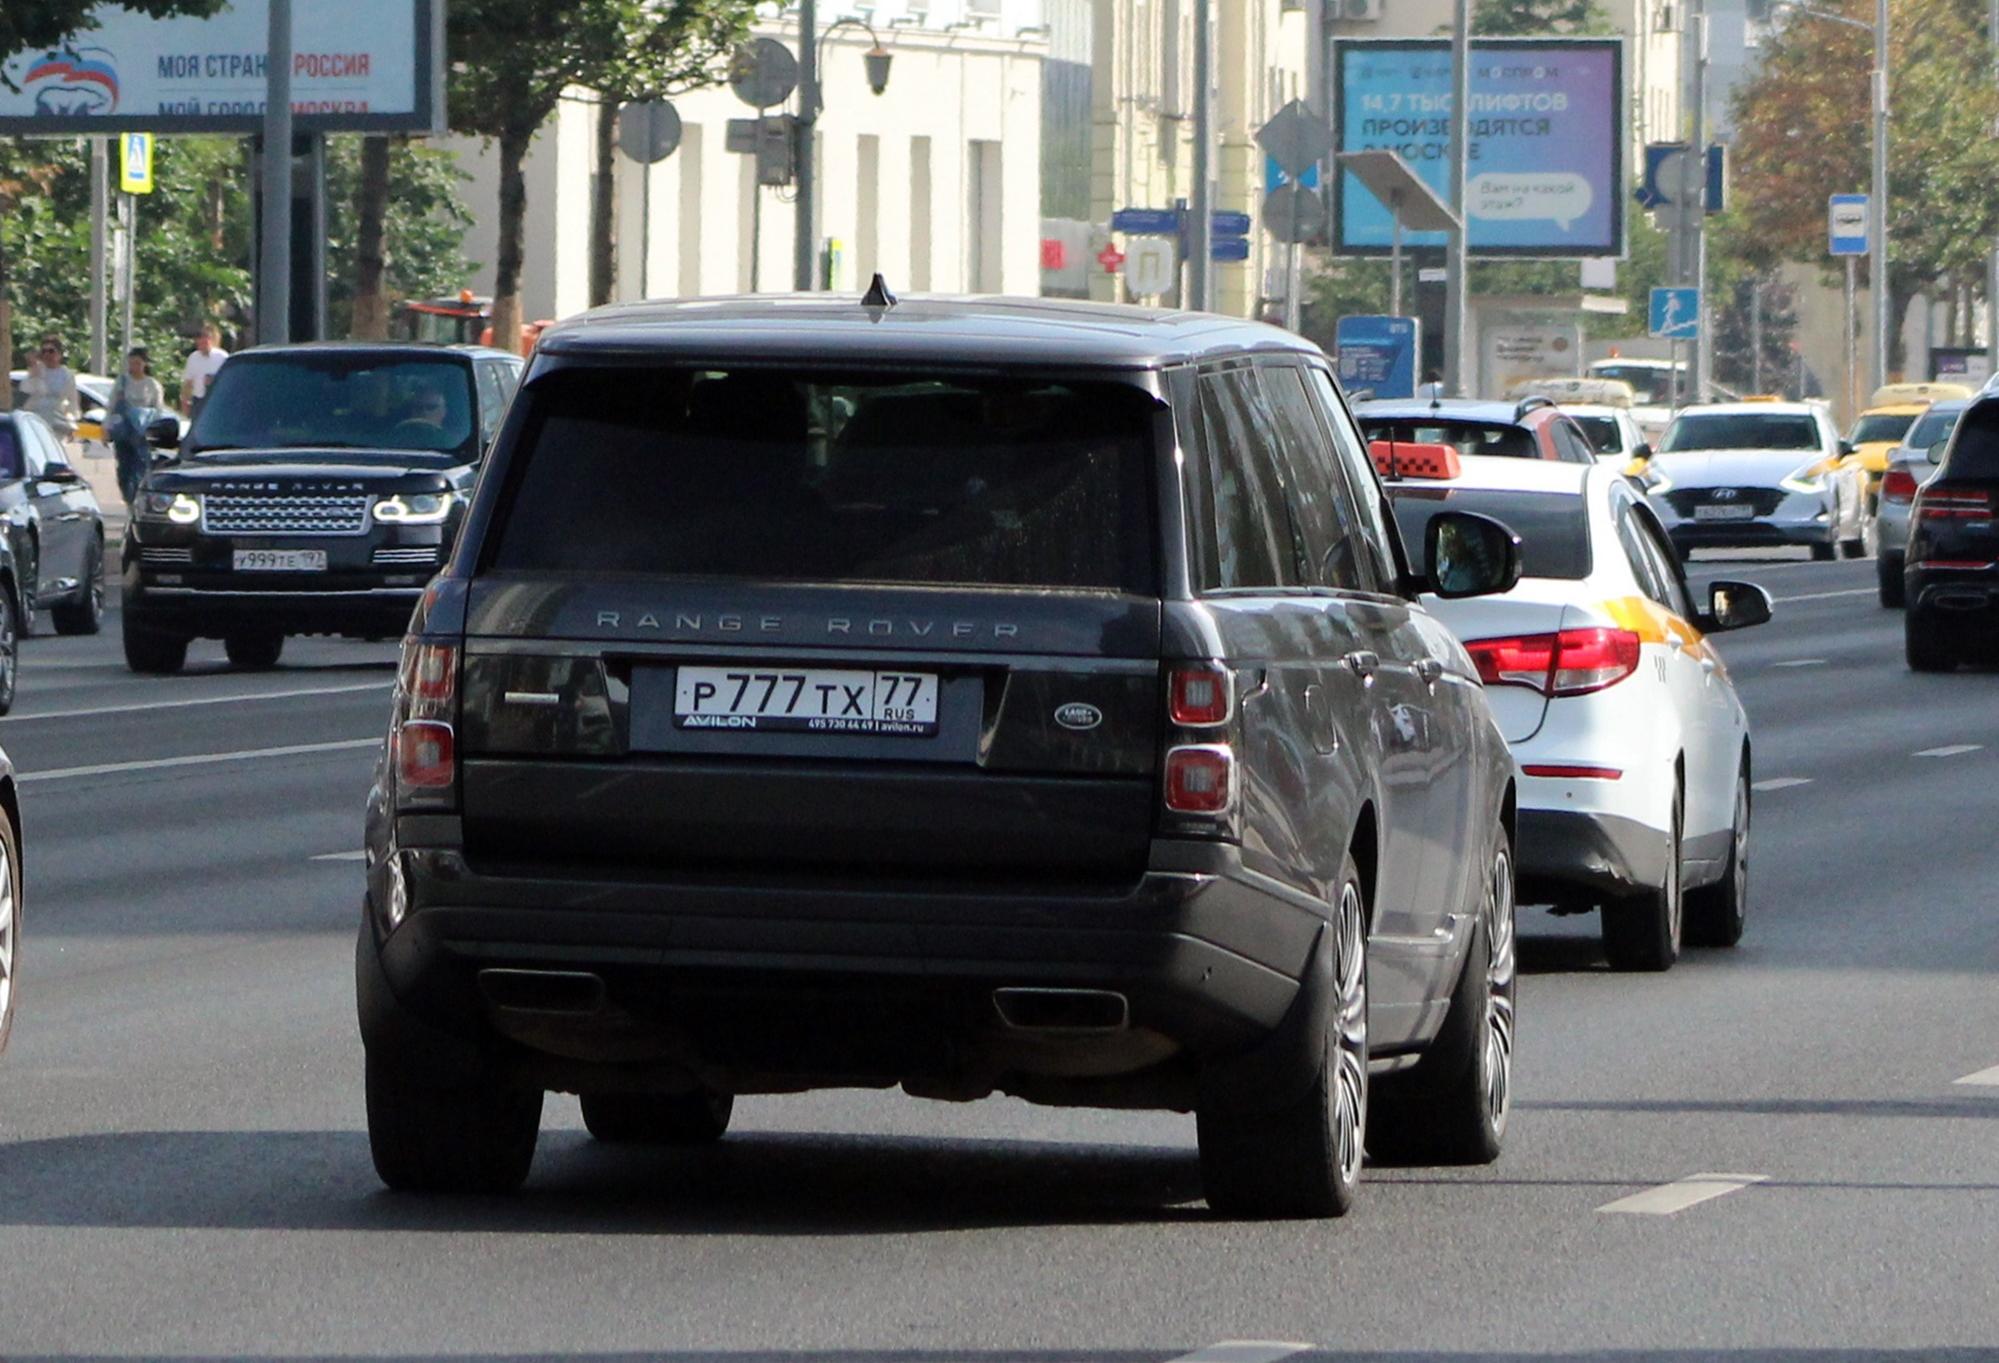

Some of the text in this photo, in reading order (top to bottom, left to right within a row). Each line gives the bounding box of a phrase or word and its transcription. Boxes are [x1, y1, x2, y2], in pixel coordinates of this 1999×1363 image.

[158, 53, 370, 78] МОЯ СТРАН РОССИЯ
[1467, 92, 1568, 112] ЛИФТОВ
[1362, 119, 1551, 138] ПРОИЗВДЯТСЯ
[597, 610, 1019, 637] RANGE ROVER
[880, 675, 923, 707] 77
[682, 715, 757, 728] AVILON
[883, 708, 916, 721] RUS
